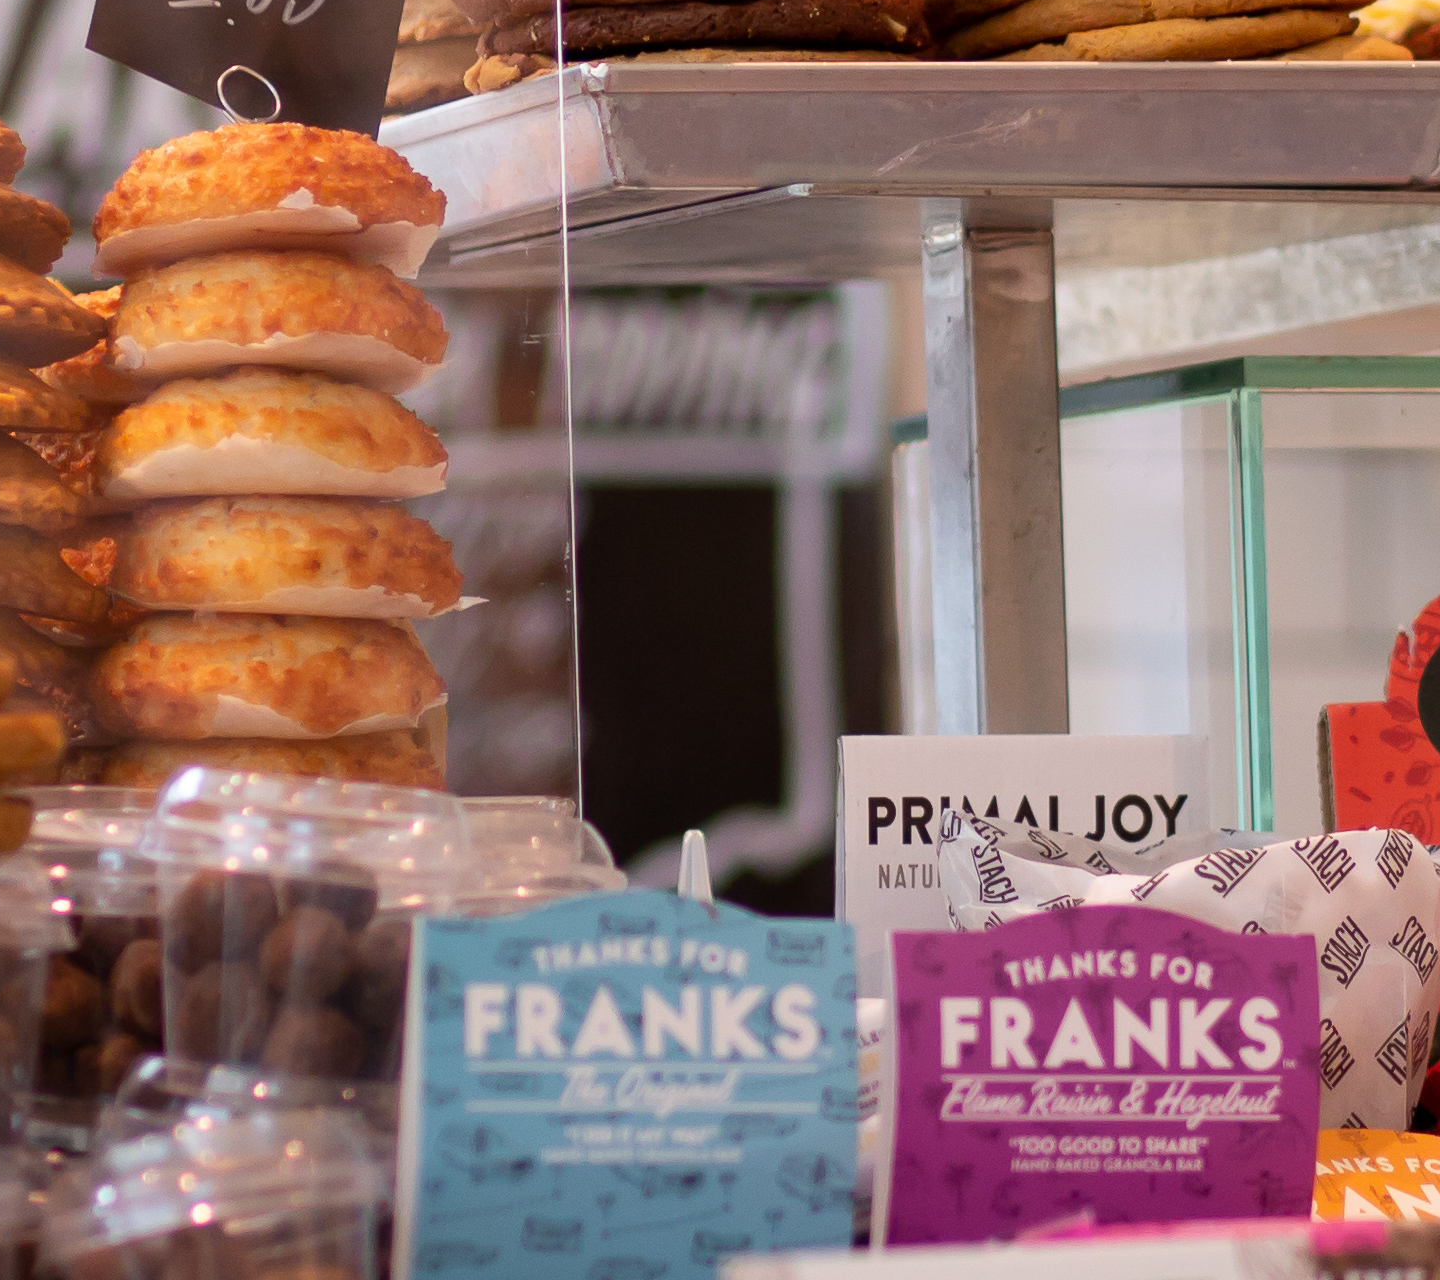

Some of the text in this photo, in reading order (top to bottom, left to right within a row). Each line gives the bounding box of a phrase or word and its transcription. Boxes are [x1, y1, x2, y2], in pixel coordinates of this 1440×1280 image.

[1084, 794, 1188, 844] JOY
[972, 844, 1019, 905] STACH
[1294, 835, 1357, 892] STACH
[534, 934, 749, 977] THANKS FOR
[1004, 951, 1214, 989] THANKS FOR
[1321, 915, 1369, 987] STACH
[1392, 916, 1439, 984] STACH
[463, 981, 822, 1060] FRANKS
[940, 997, 1283, 1071] FRANKS
[1119, 1077, 1145, 1115] &
[1154, 1078, 1282, 1130] Hazelnut
